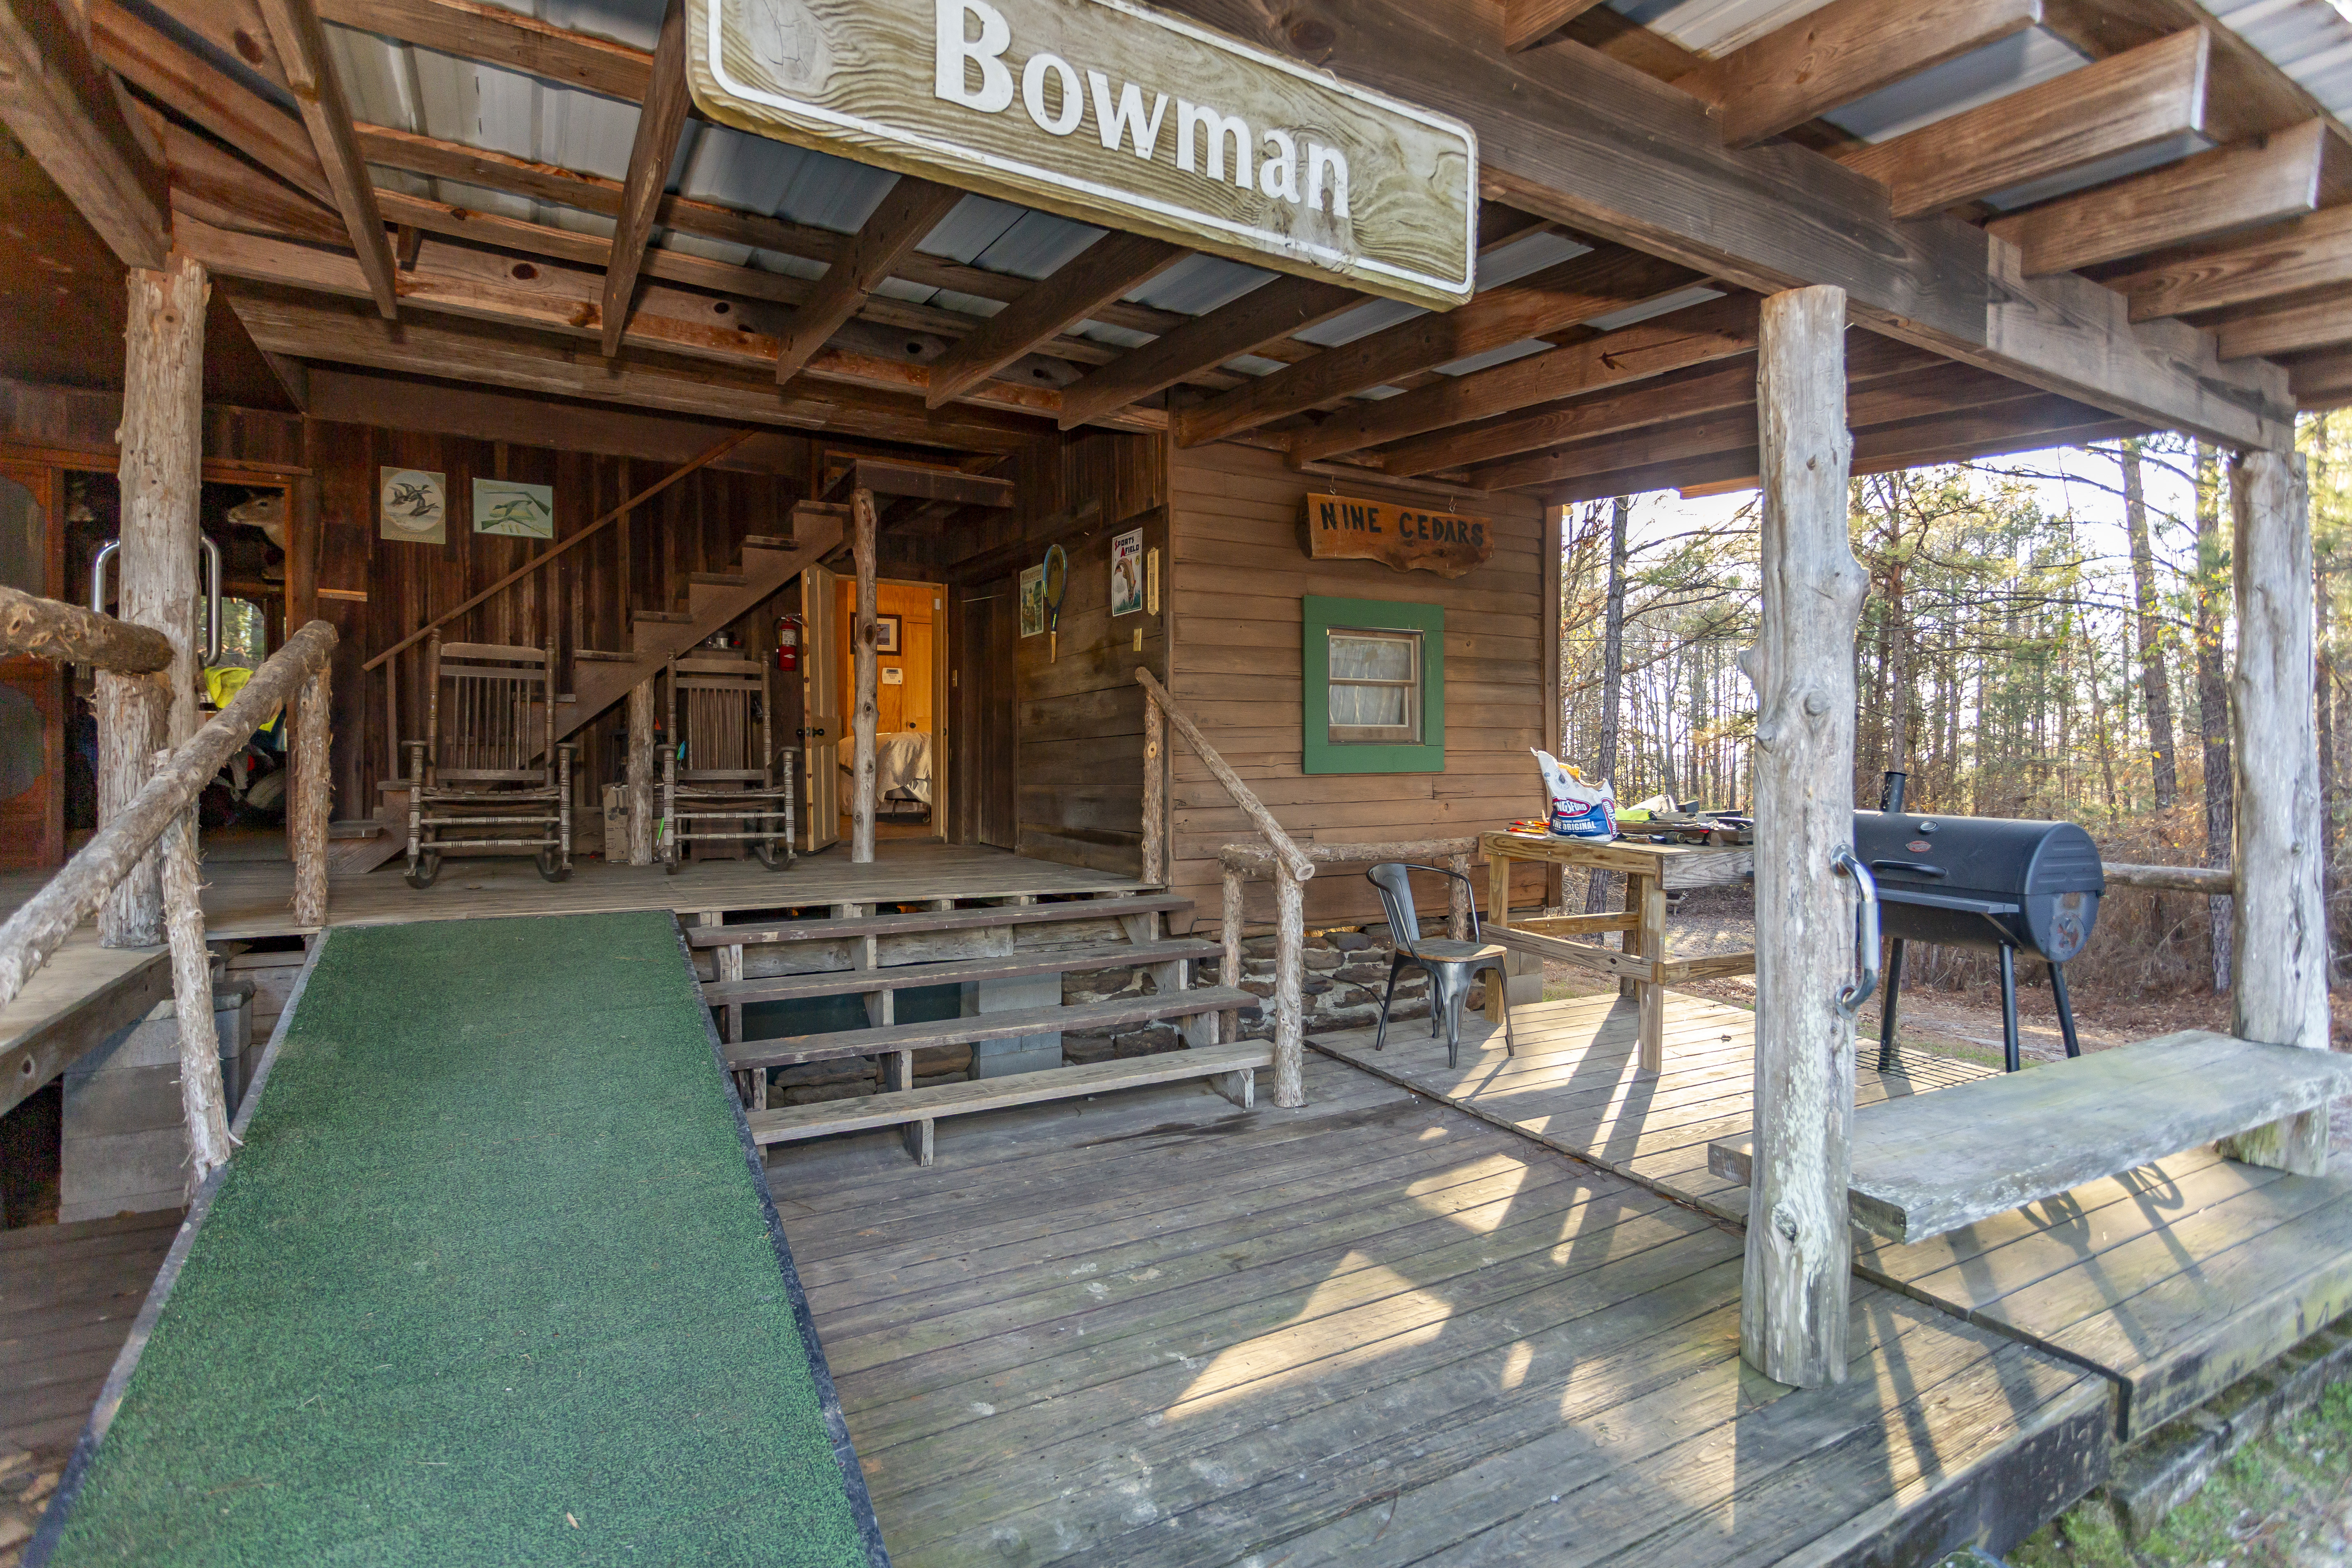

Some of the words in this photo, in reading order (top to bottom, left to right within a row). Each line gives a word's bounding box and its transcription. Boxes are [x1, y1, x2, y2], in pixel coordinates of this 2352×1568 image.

[935, 0, 1349, 219] Bowman
[1320, 503, 1382, 533] NINE
[1399, 512, 1484, 547] CEDARS
[1115, 536, 1134, 551] SPORTS
[1552, 819, 1562, 829] THE
[1562, 821, 1597, 831] ORIGINAL
